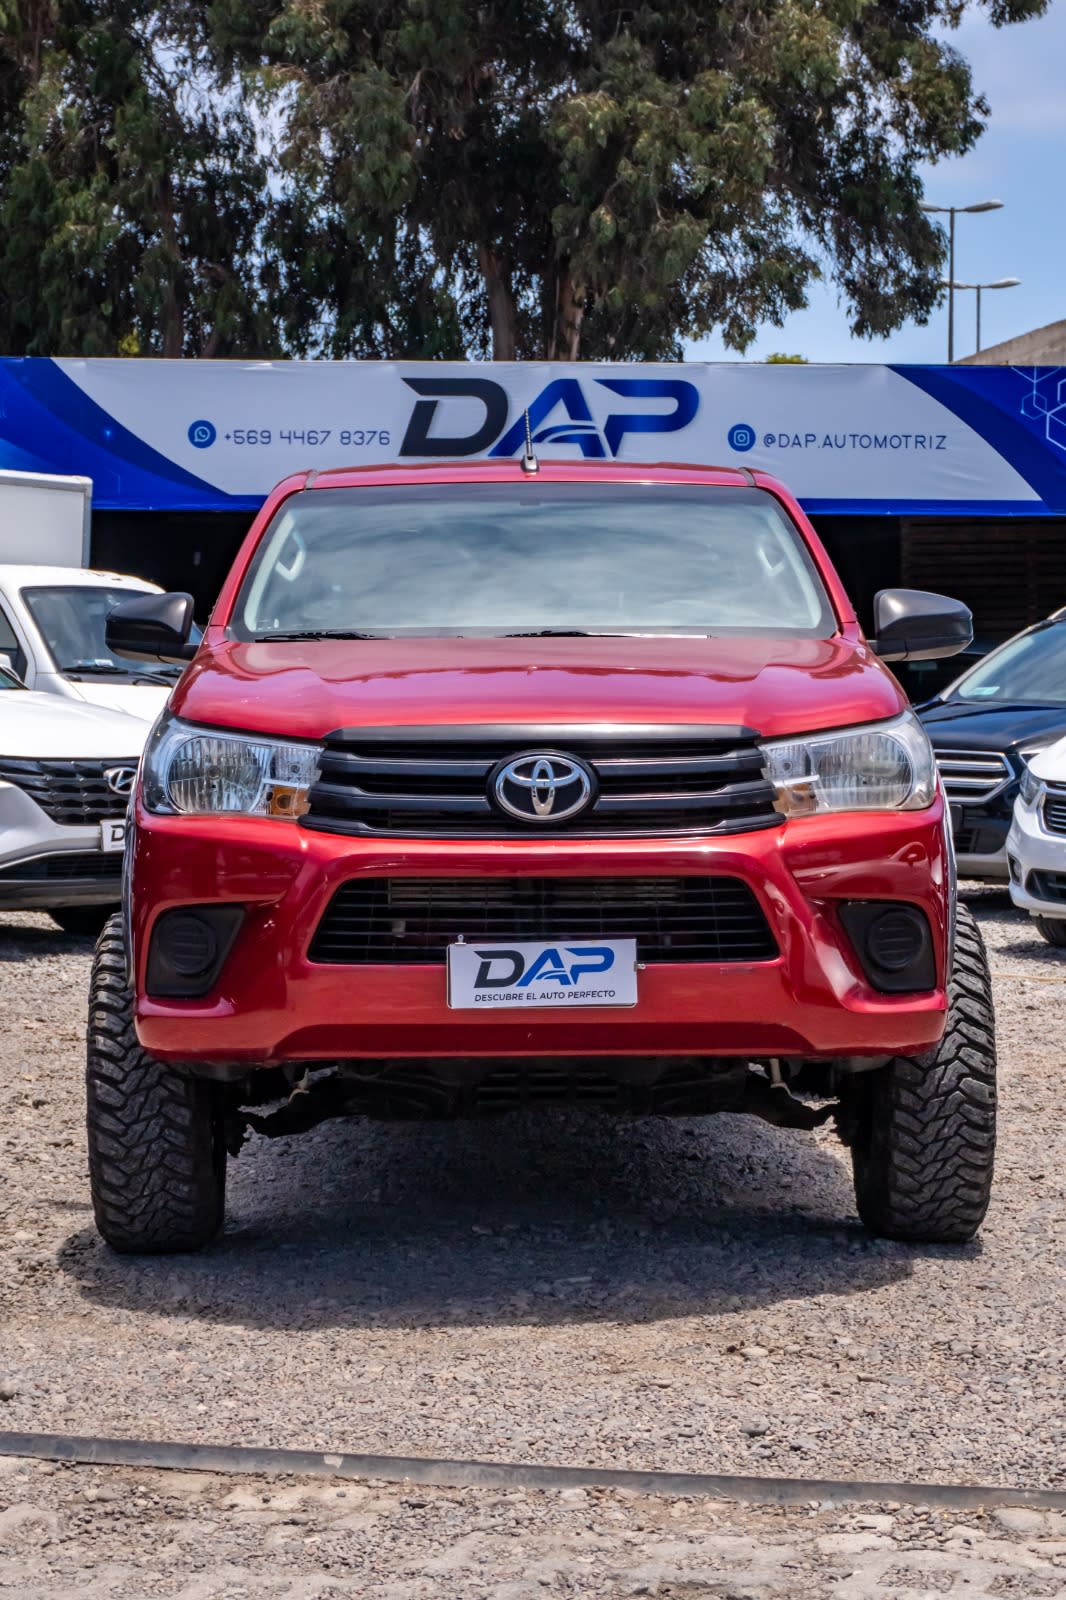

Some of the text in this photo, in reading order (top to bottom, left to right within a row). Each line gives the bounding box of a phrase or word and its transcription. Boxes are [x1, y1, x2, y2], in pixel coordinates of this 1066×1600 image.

[398, 377, 701, 458] DAP
[224, 429, 390, 446] +569 4467 8376
[763, 433, 948, 450] @DAP.AUTOMOTRIZ
[473, 946, 615, 989] DAP
[474, 990, 616, 1002] DESCUBRE EL AUTO PERFECTO
